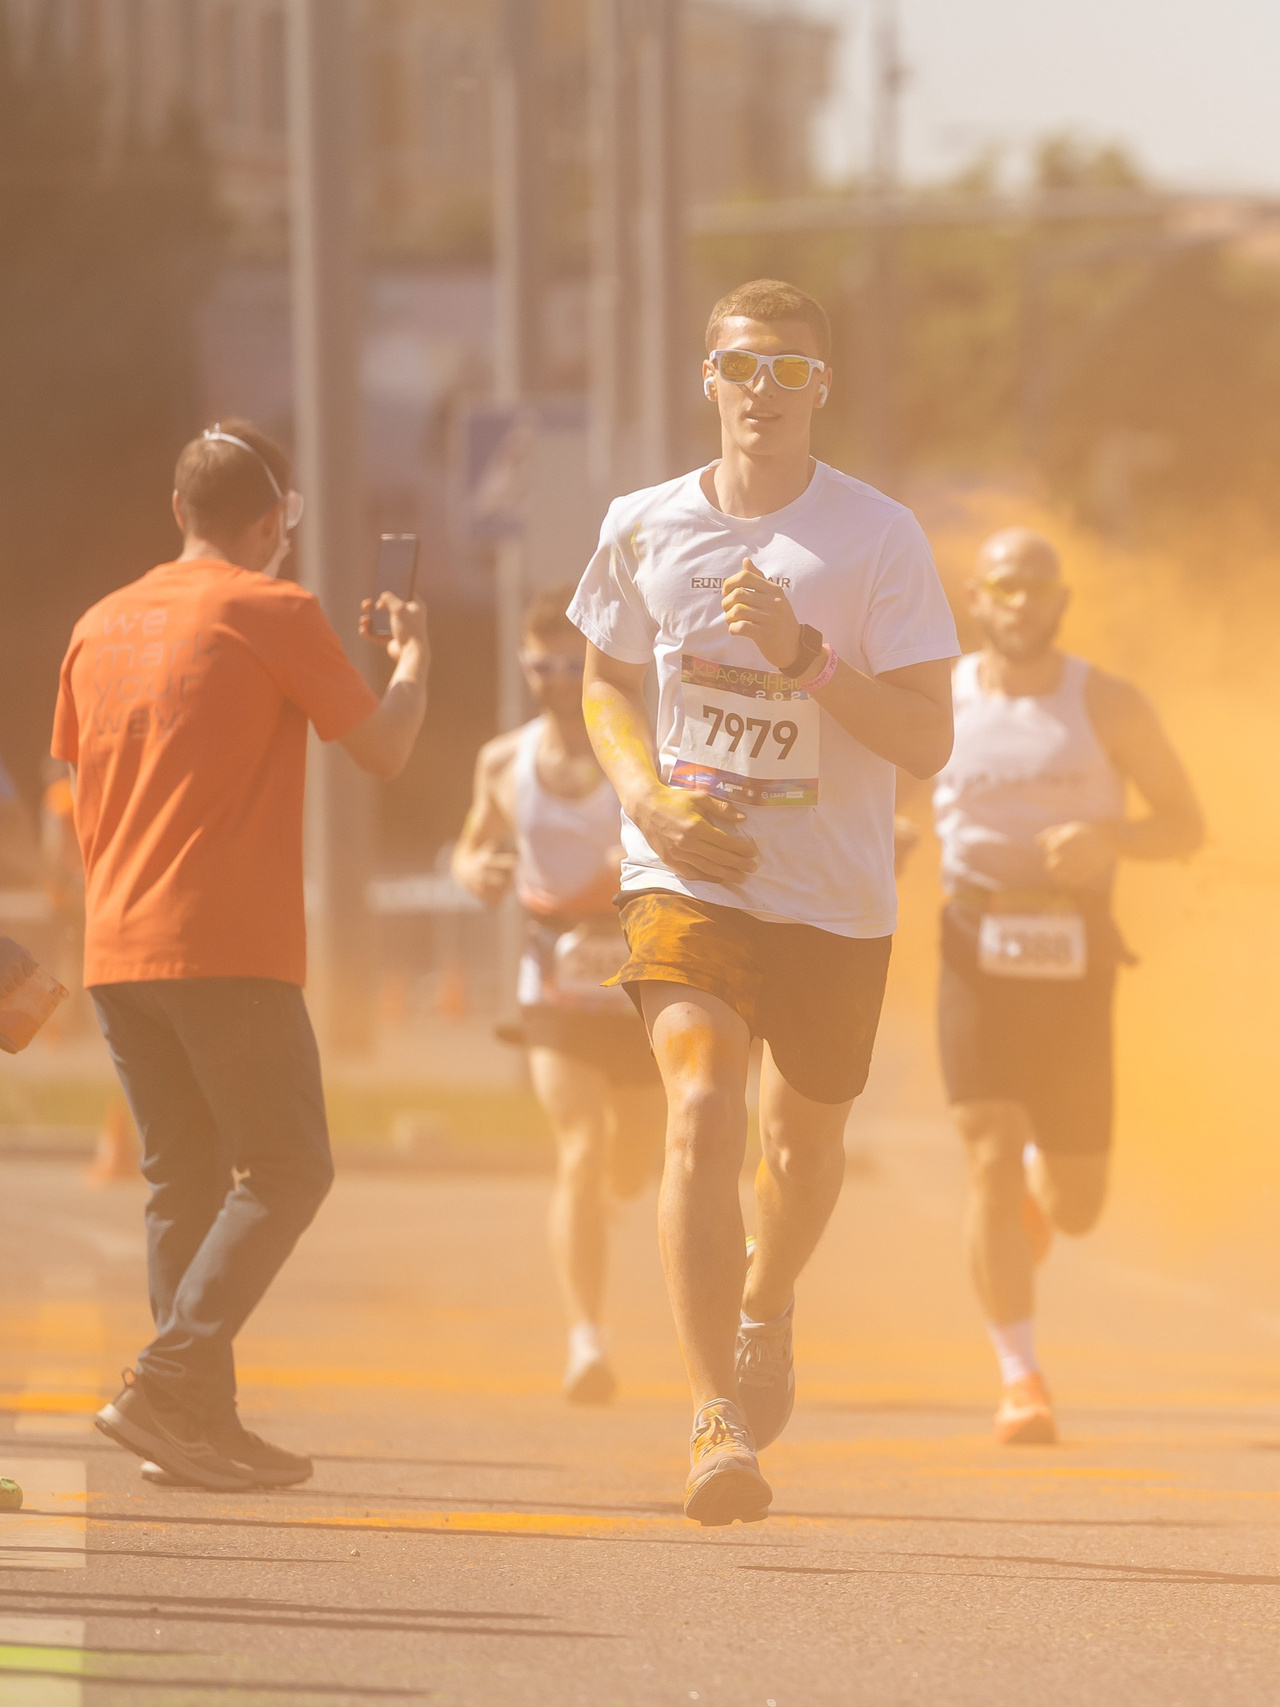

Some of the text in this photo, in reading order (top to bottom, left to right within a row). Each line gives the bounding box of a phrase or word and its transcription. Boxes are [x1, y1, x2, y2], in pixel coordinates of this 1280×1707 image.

[103, 608, 168, 636] we
[95, 633, 219, 668] mark
[94, 674, 204, 711] your
[703, 705, 798, 760] 7979
